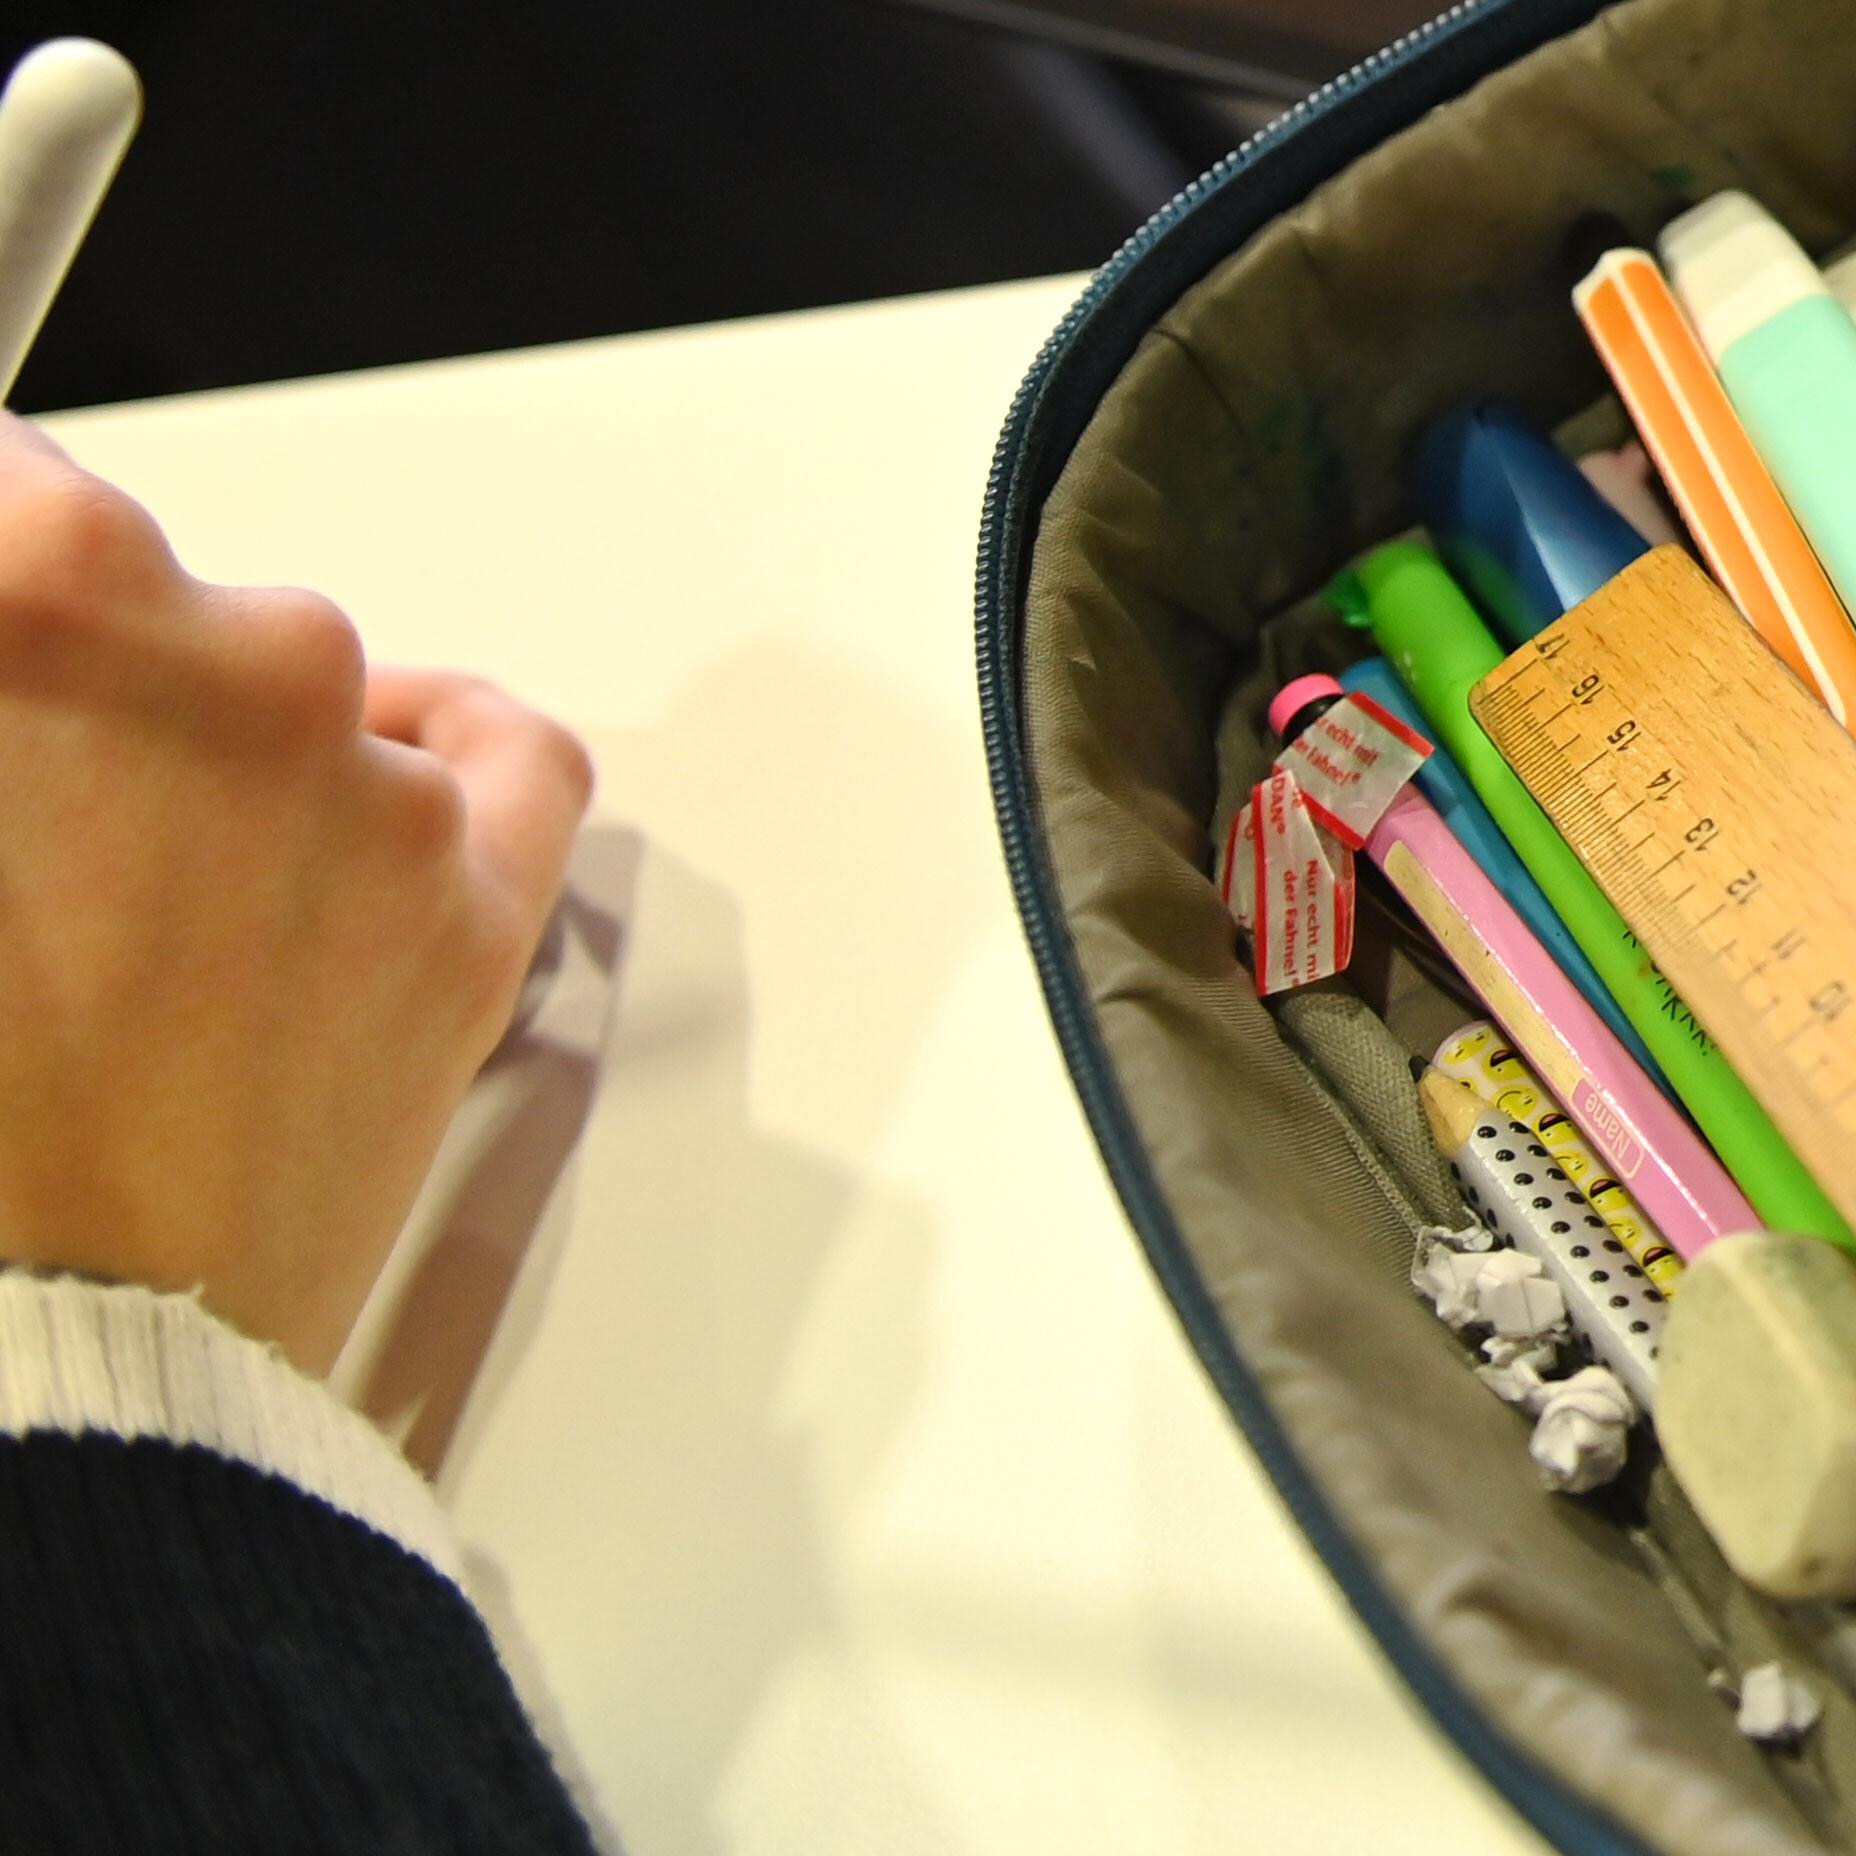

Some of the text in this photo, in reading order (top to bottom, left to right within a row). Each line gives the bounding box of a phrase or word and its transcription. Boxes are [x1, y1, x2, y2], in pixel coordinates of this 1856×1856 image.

[1535, 632, 1571, 661] 17
[1571, 673, 1606, 705] 16
[1606, 719, 1642, 753] 15
[1646, 767, 1681, 801] 14
[1685, 817, 1719, 852] 13
[1283, 870, 1302, 902] der
[1305, 859, 1319, 898] Nur
[1306, 901, 1322, 948] echt
[1582, 1092, 1631, 1160] Name
